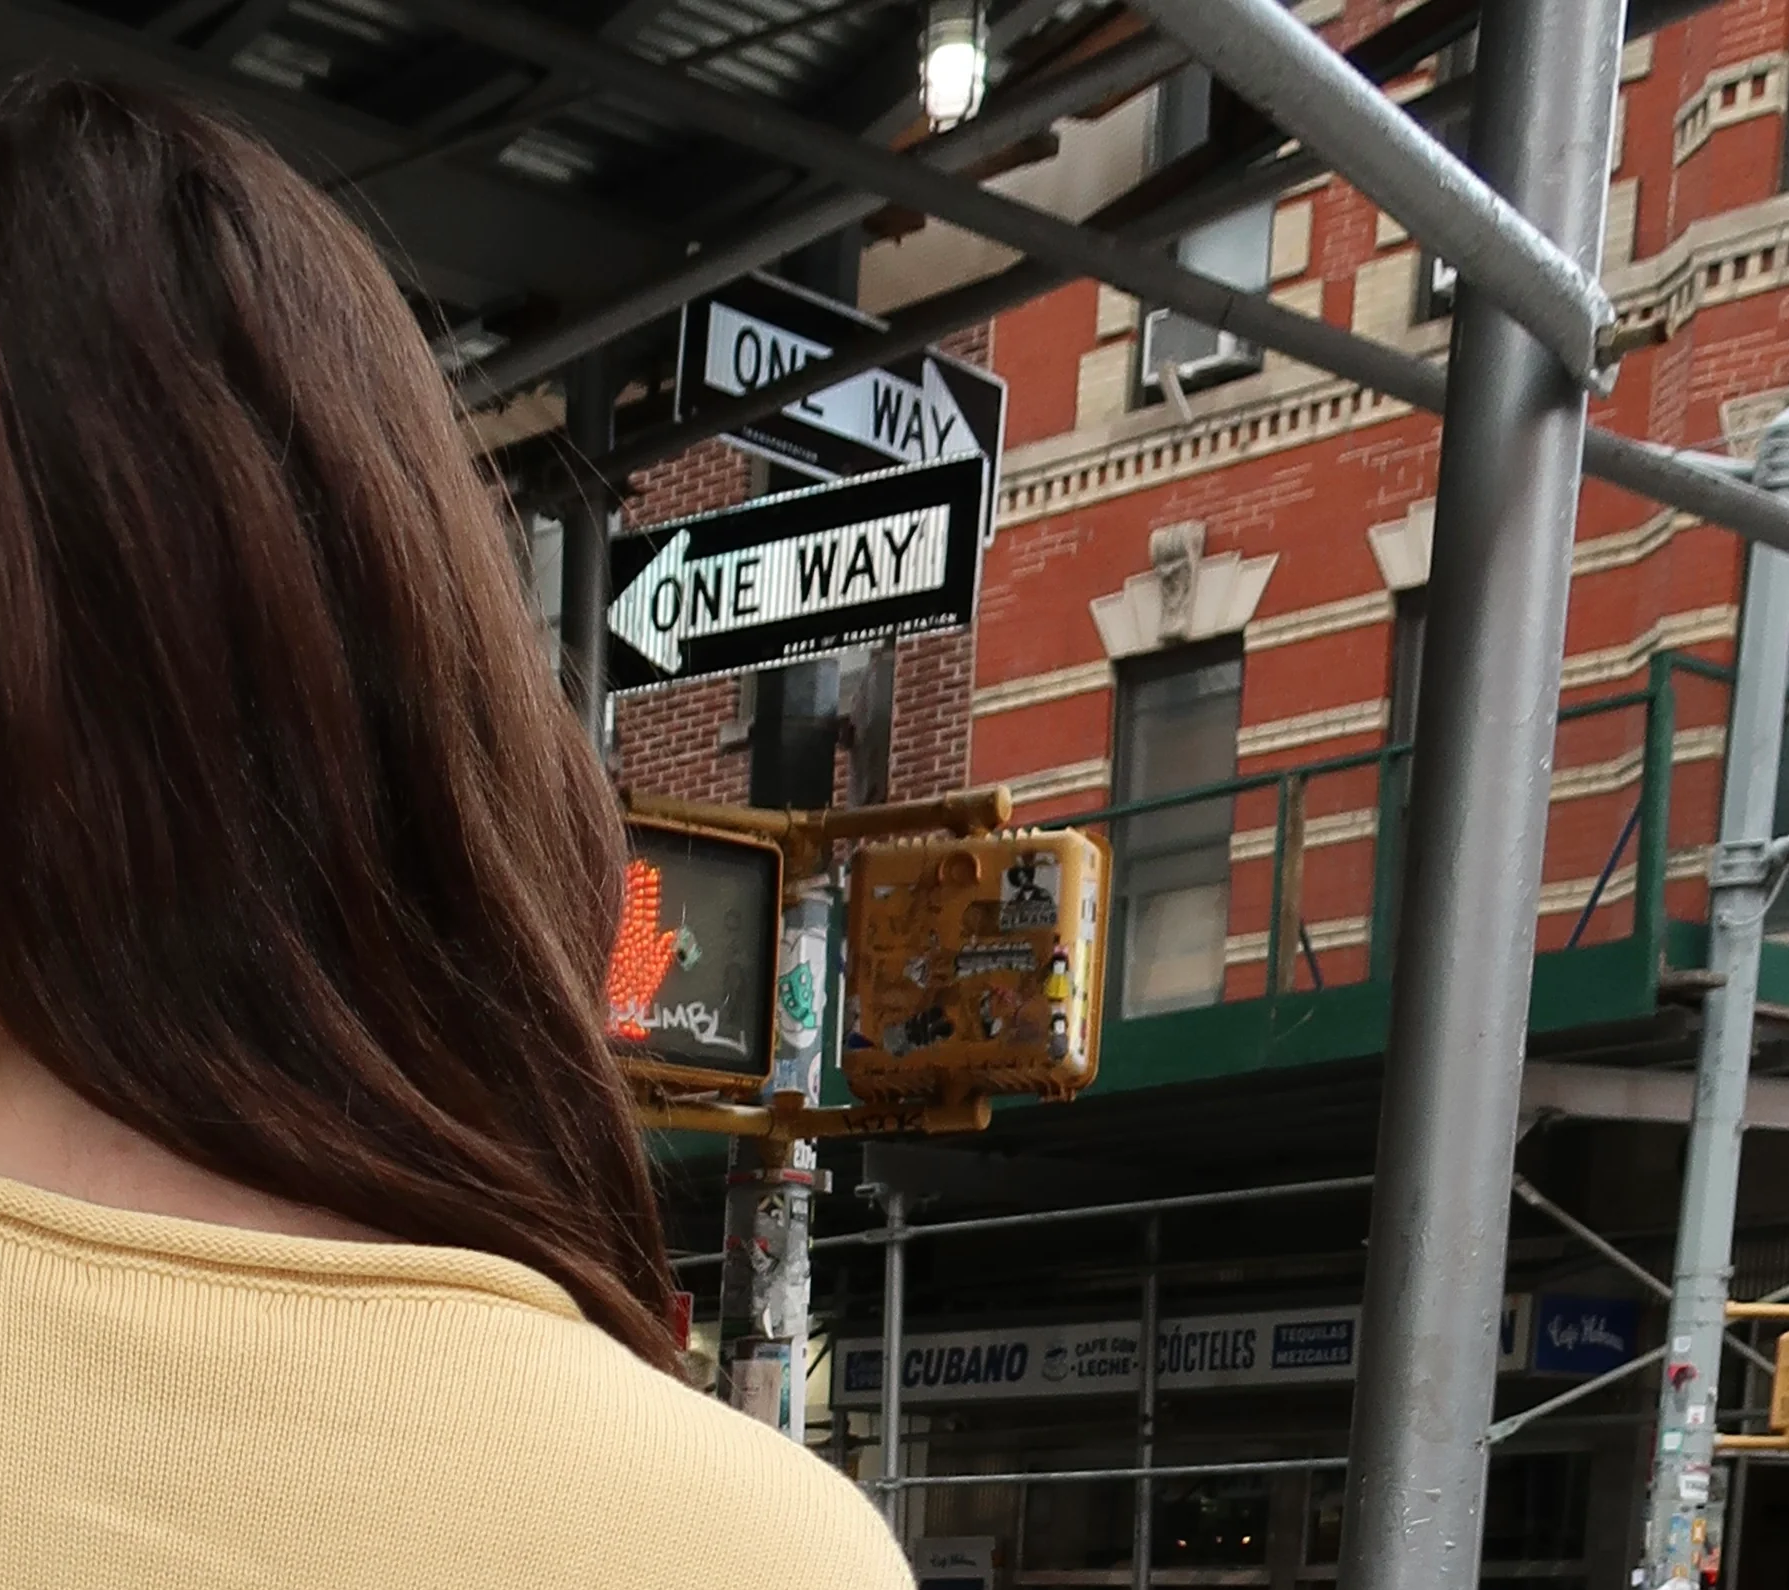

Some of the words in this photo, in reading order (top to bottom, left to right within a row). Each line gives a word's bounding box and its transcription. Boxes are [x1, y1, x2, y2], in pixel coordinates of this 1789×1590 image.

[874, 378, 956, 460] WAY
[652, 558, 759, 632] ONE
[798, 522, 920, 603] WAY
[1155, 1324, 1254, 1374] CÓCTELES
[1276, 1347, 1348, 1363] MEZCALES
[1281, 1324, 1348, 1342] TEQUILAS
[902, 1343, 1027, 1388] CUBANO
[1078, 1358, 1129, 1377] LECHE
